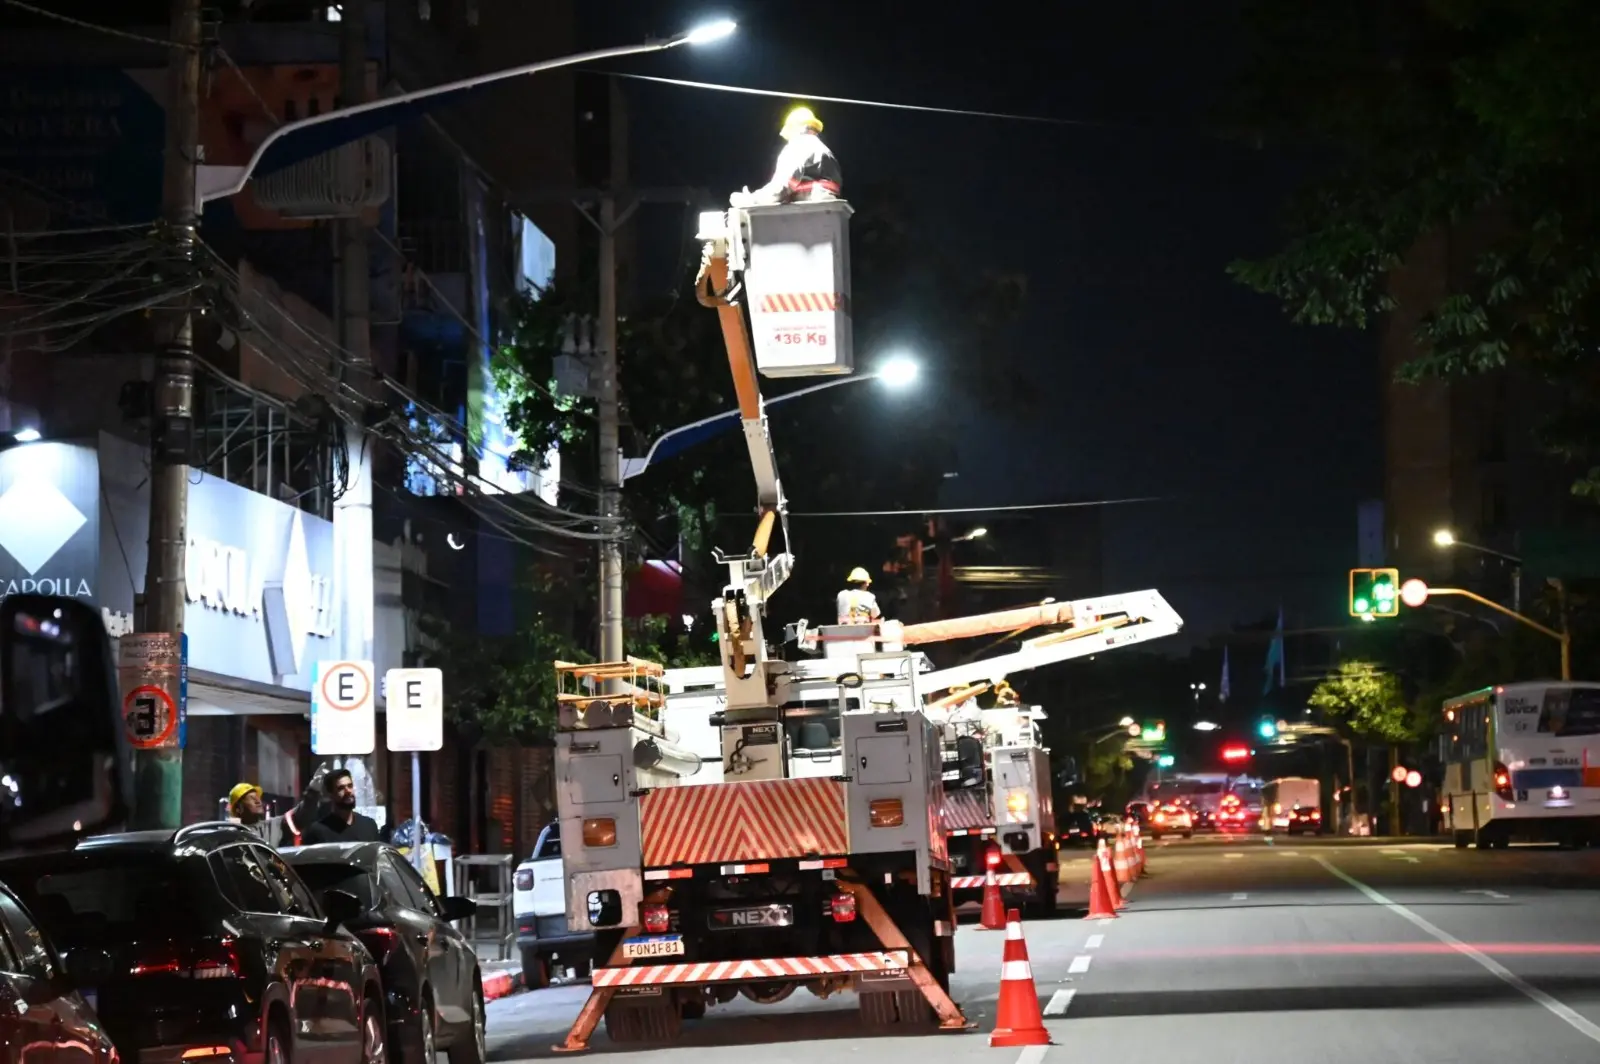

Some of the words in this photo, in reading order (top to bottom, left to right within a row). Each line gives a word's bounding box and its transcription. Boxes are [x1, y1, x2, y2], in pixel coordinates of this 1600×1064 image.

[774, 333, 802, 345] 136
[807, 332, 827, 346] Kg
[338, 672, 355, 701] E
[406, 680, 422, 709] E
[752, 725, 776, 733] NEXT
[731, 909, 788, 926] NEXT
[628, 941, 679, 956] FON1F81
